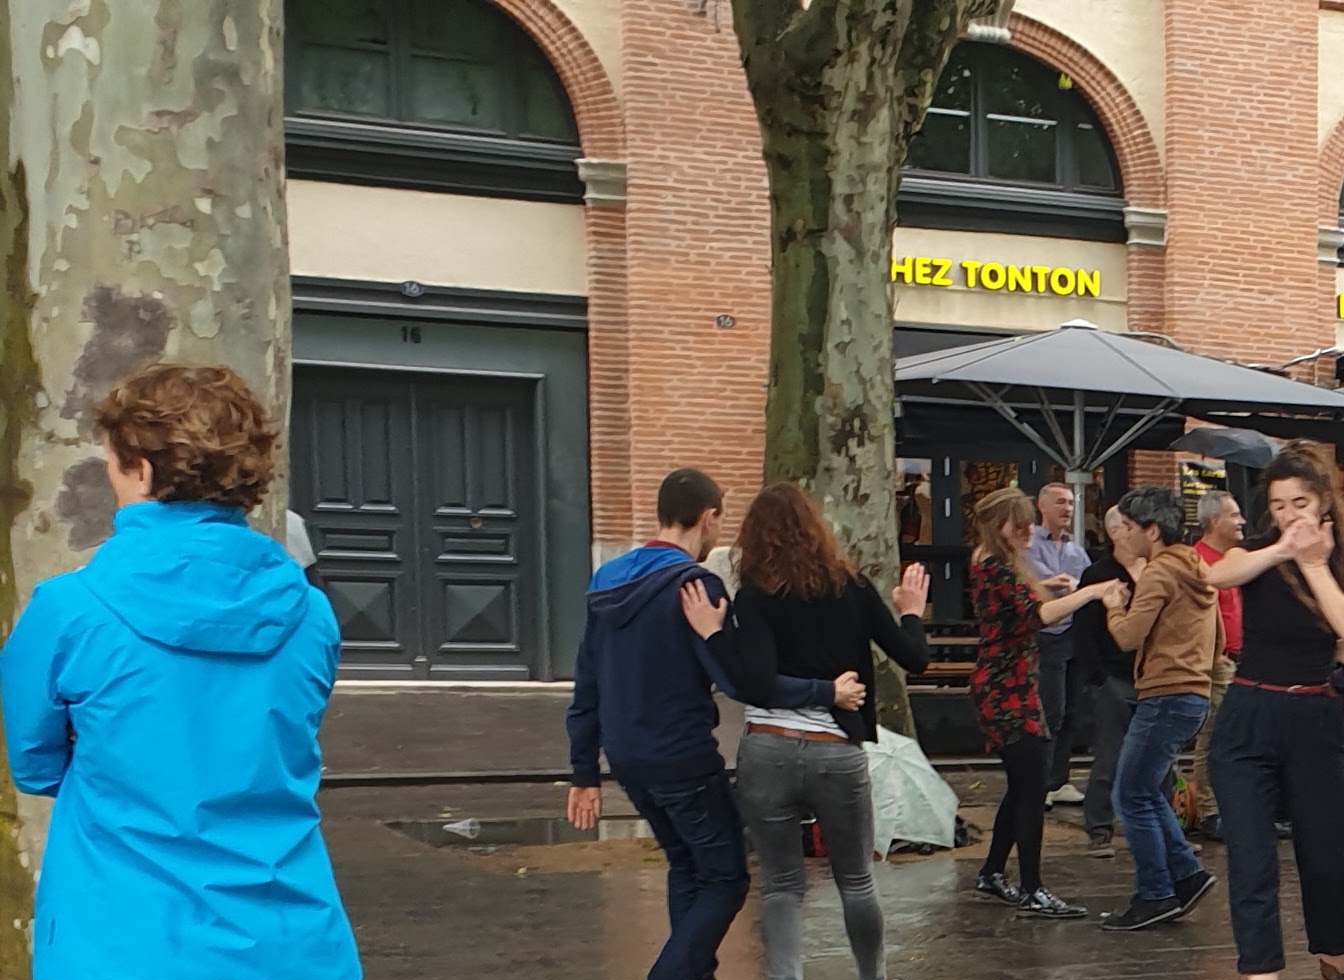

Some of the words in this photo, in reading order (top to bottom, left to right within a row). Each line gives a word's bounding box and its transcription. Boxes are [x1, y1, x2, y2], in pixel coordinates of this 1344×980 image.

[891, 256, 953, 286] HEZ
[960, 260, 1101, 297] TONTON
[401, 326, 422, 344] 16
